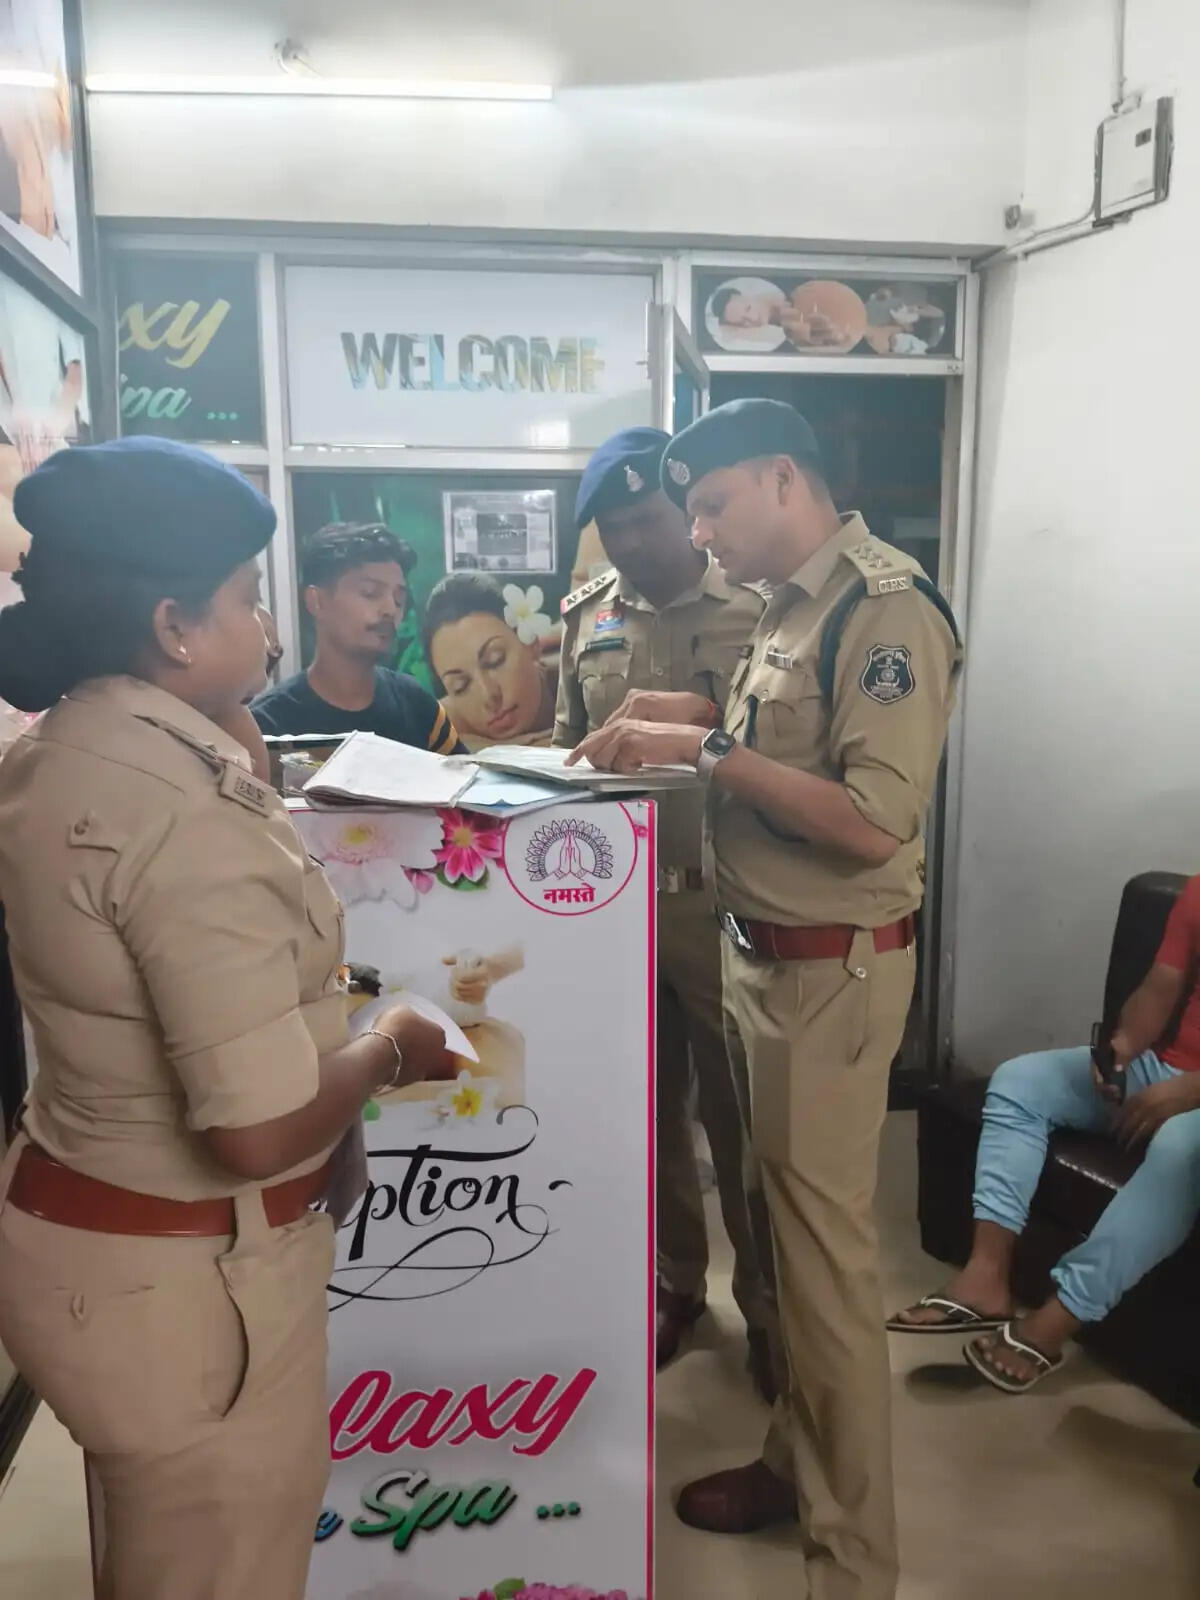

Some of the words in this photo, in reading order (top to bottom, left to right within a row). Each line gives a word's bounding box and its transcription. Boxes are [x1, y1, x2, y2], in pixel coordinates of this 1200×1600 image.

[119, 298, 231, 368] xy
[340, 332, 604, 393] WELCOME
[120, 373, 193, 419] pa
[543, 882, 597, 904] नमस्ते
[335, 1106, 562, 1265] ption
[328, 1368, 598, 1461] laxy
[349, 1468, 519, 1554] Spa
